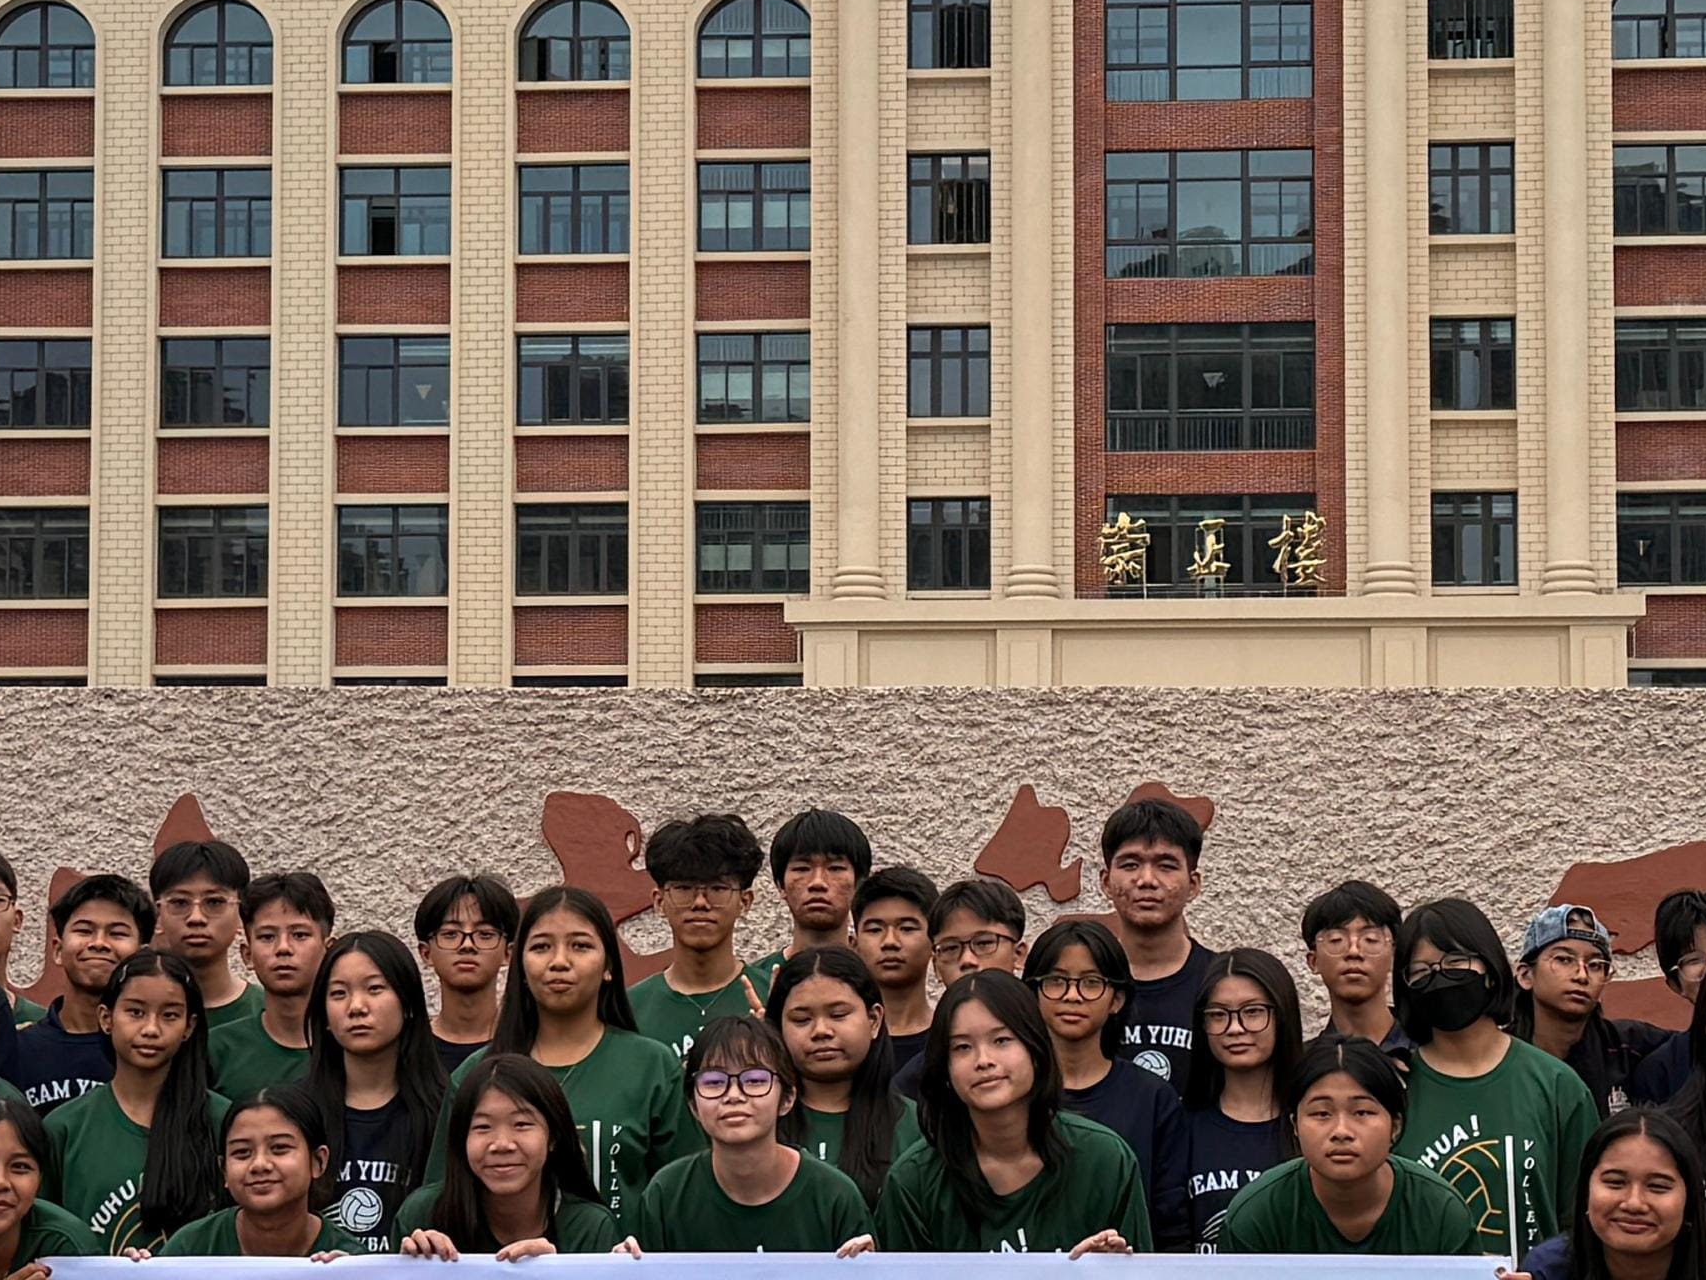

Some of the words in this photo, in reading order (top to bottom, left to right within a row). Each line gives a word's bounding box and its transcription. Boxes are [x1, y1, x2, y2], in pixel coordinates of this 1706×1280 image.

[1147, 1024, 1193, 1050] YUH
[26, 1079, 71, 1108] EAM
[1417, 1114, 1481, 1169] HUA!
[610, 1124, 622, 1219] VOLLE
[1188, 1169, 1239, 1199] EAM
